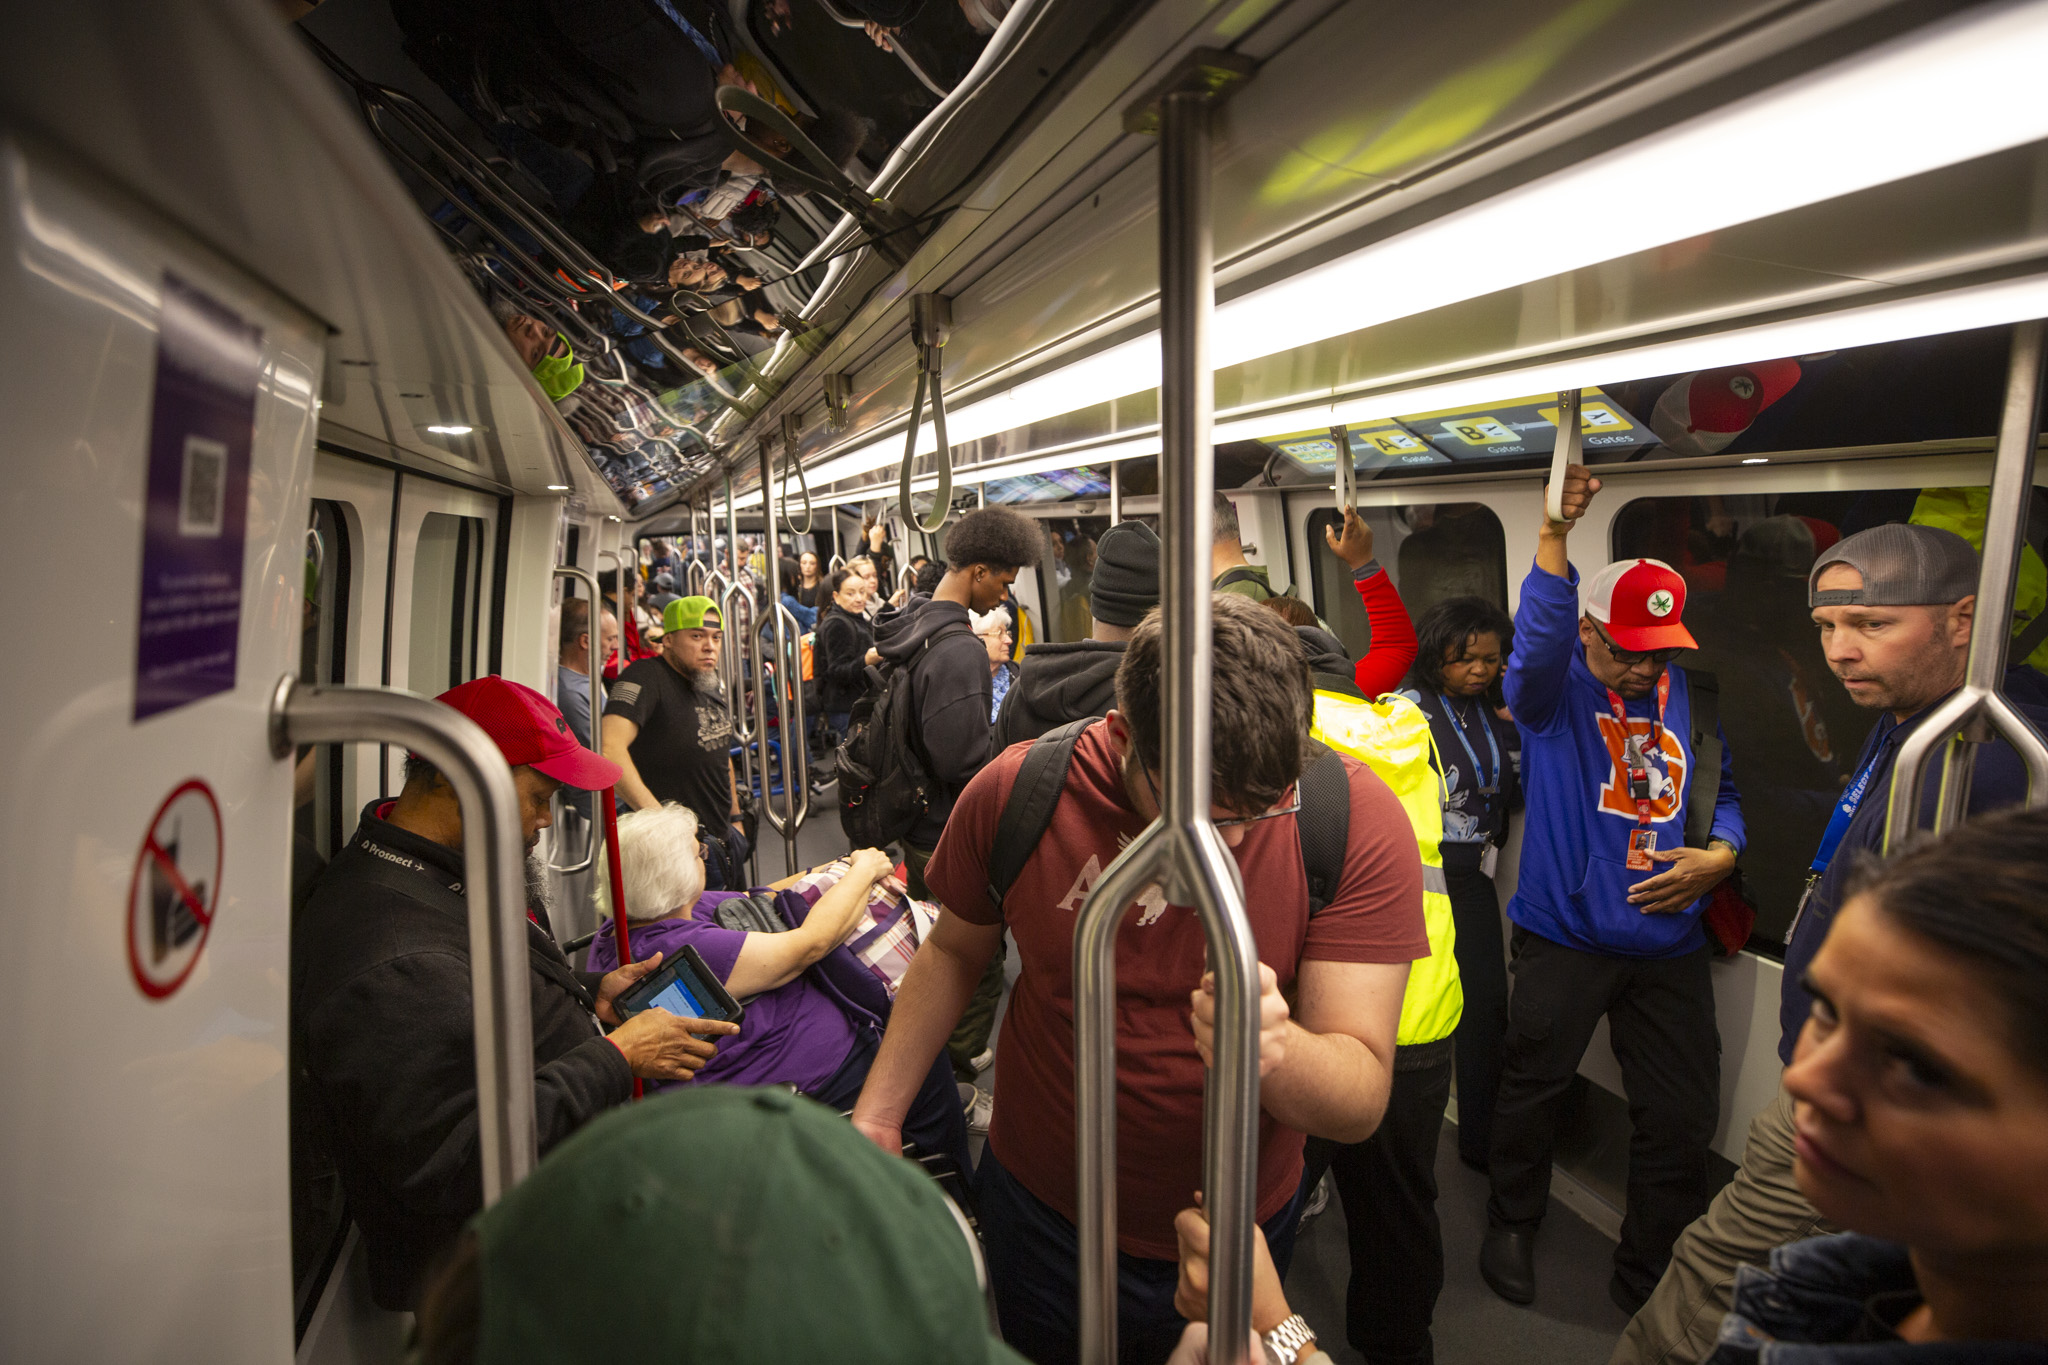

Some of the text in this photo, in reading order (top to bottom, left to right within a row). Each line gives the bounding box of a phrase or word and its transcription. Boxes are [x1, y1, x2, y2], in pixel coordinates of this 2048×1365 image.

[1455, 426, 1486, 440] B
[1587, 434, 1635, 446] Gates
[1375, 437, 1401, 452] A
[1487, 444, 1525, 455] Gates
[1848, 771, 1870, 804] SELECT
